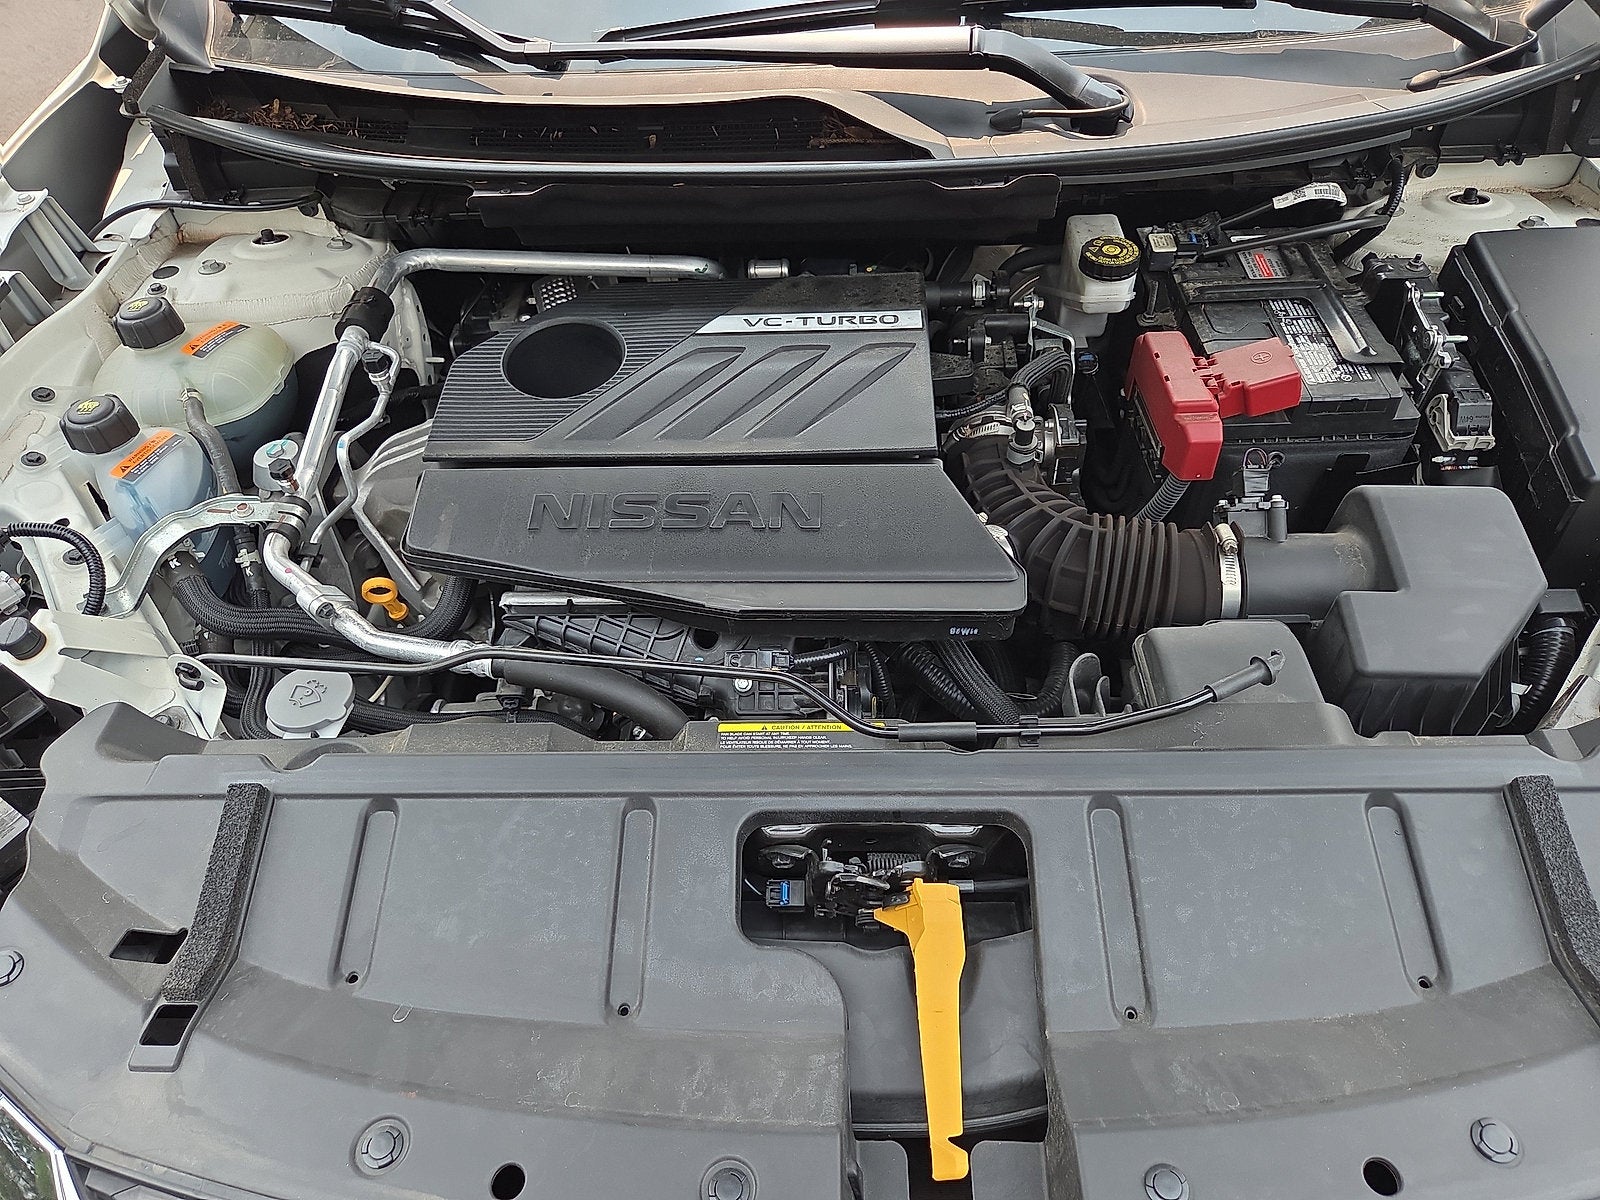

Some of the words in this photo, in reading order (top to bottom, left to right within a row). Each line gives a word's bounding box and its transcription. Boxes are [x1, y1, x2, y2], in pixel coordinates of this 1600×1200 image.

[742, 314, 899, 328] VC-TURBO
[527, 492, 823, 530] NISSAN
[168, 557, 181, 569] K
